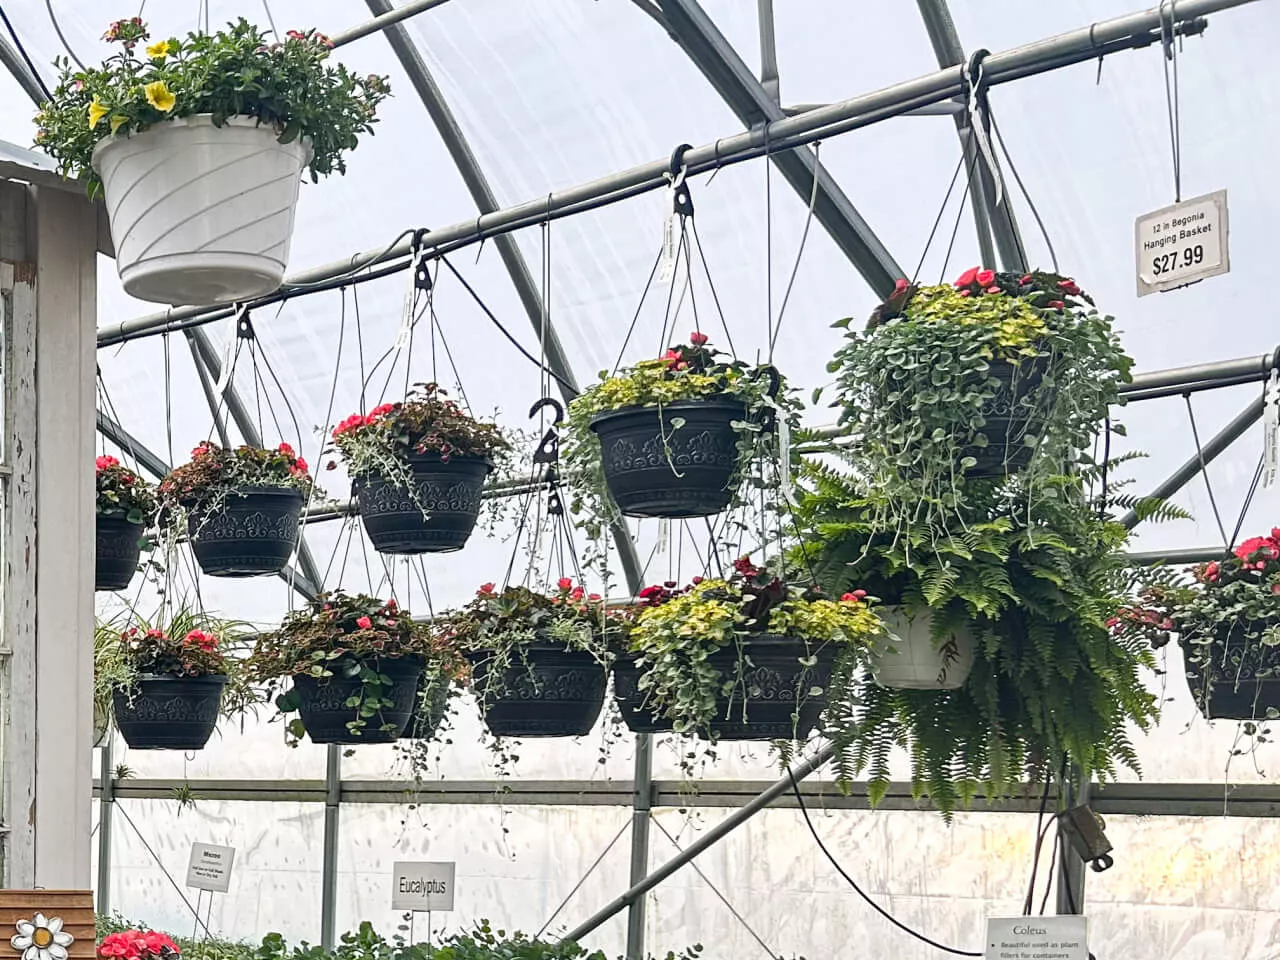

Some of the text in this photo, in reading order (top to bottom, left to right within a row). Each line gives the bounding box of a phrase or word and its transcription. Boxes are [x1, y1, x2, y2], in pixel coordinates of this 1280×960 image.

[1153, 212, 1205, 234] 12 in Begonia
[1144, 223, 1212, 251] Hanging Basket
[1153, 245, 1204, 276] $27.99
[399, 876, 446, 898] Eucalyptus
[1013, 925, 1047, 935] Coleus
